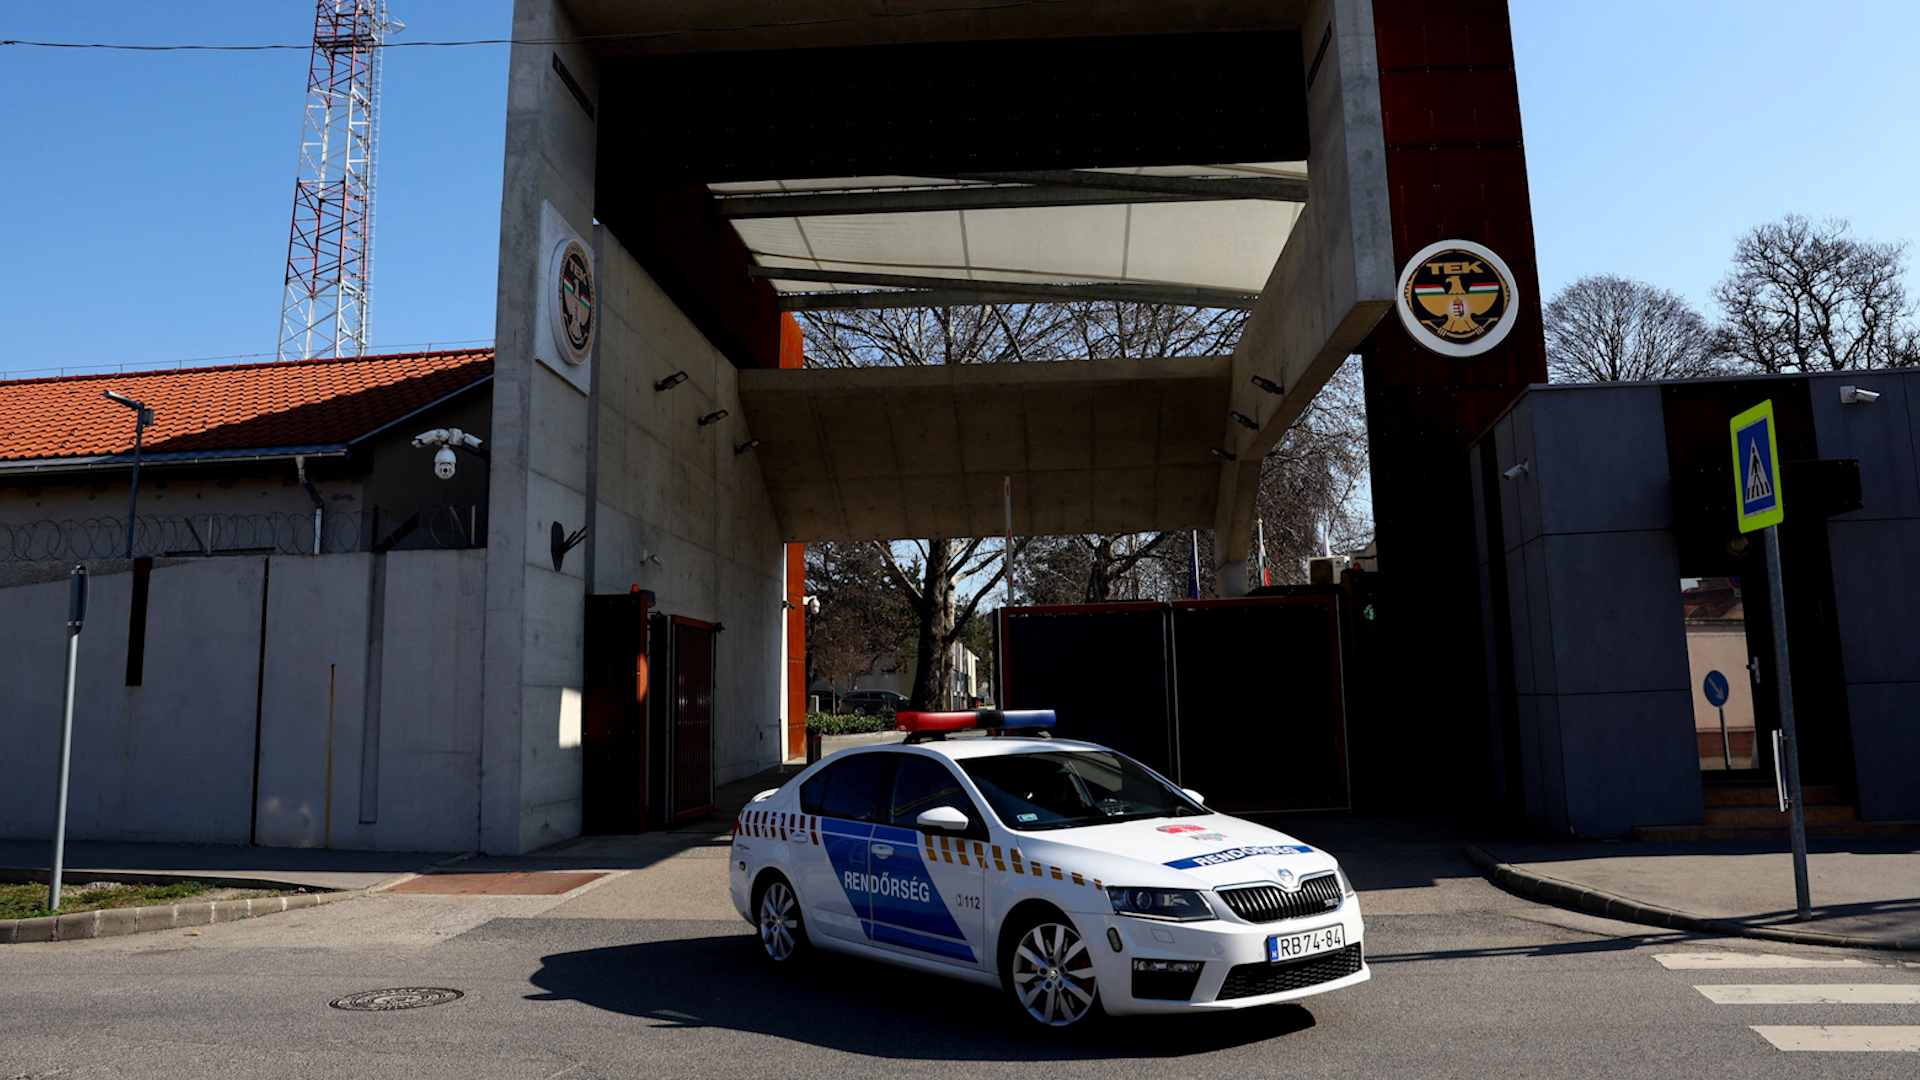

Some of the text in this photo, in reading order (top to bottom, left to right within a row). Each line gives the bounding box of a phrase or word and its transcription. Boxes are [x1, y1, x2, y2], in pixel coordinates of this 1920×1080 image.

[569, 257, 588, 285] TEK
[1426, 261, 1484, 275] TEK
[844, 871, 930, 903] RENDŐRSÉG
[964, 896, 980, 909] 112
